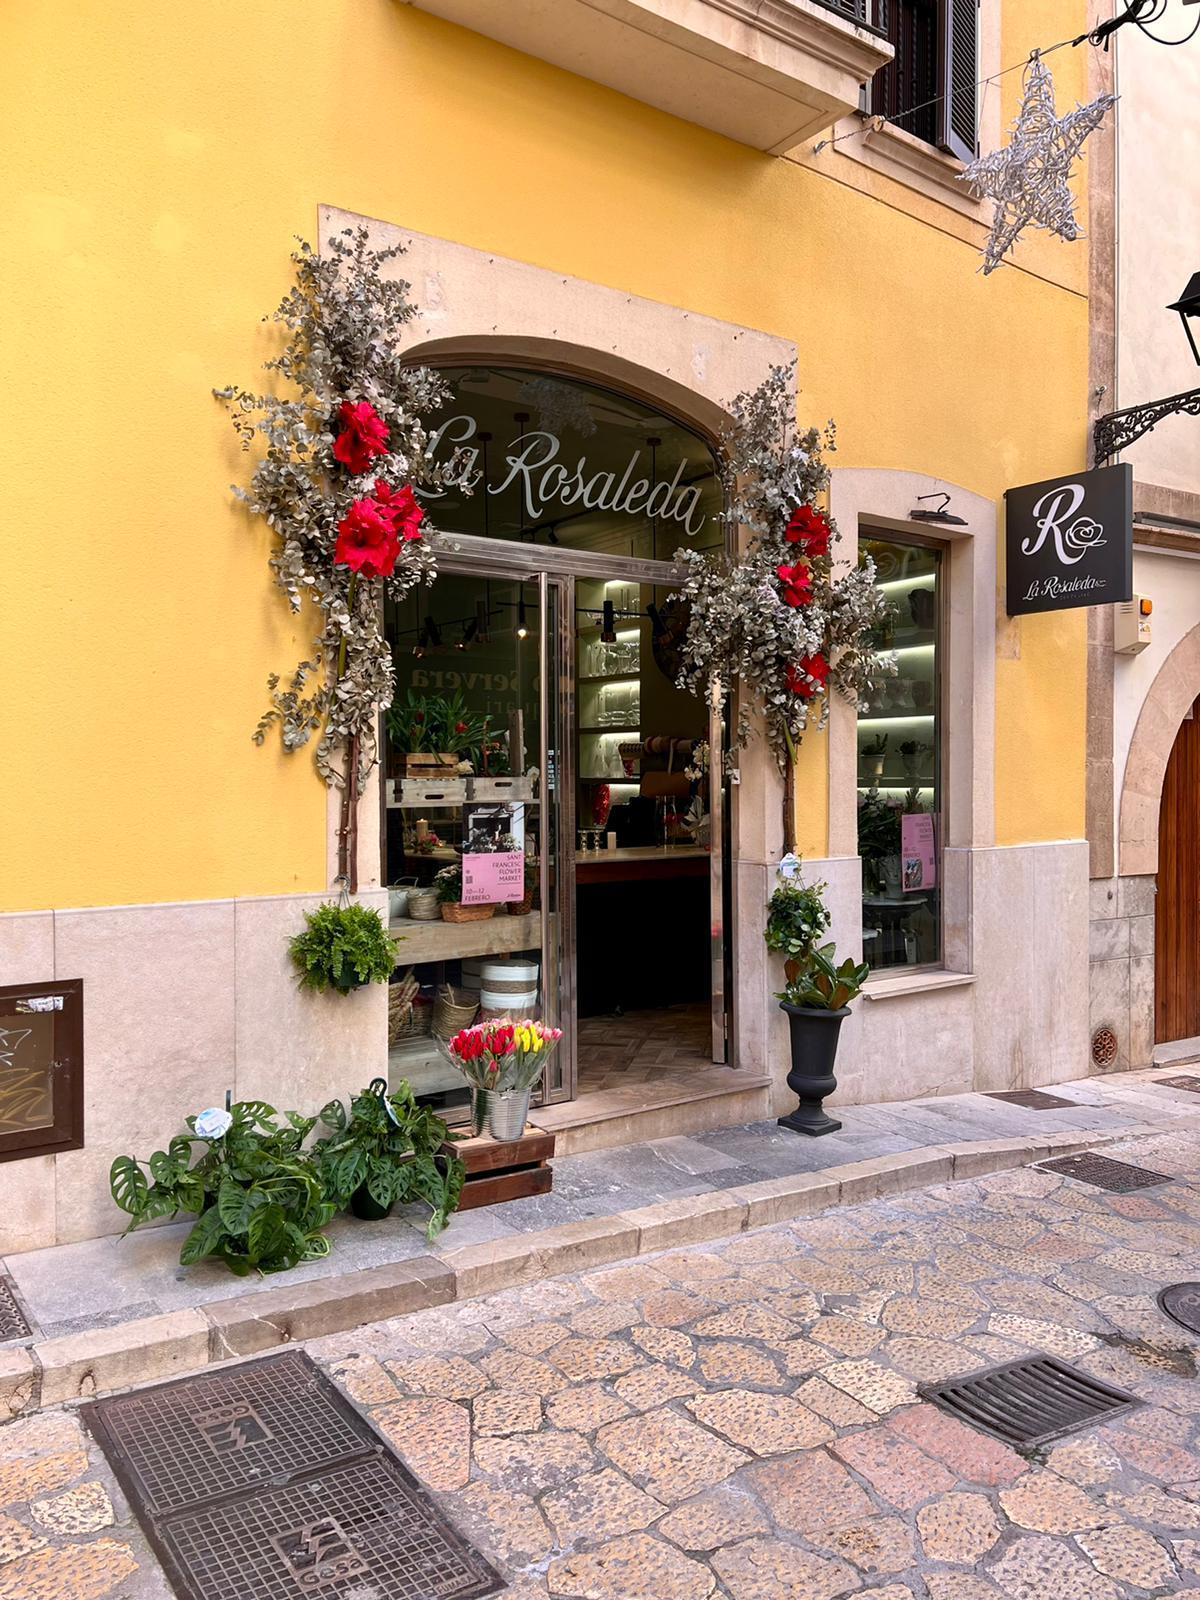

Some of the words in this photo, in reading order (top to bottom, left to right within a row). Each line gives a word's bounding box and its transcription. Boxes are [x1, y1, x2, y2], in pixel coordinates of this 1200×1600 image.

[413, 415, 481, 499] La
[487, 431, 706, 536] Rosaleda
[1022, 580, 1040, 601] La
[1041, 574, 1096, 599] Rosaleda
[300, 1559, 363, 1585] Gesa
